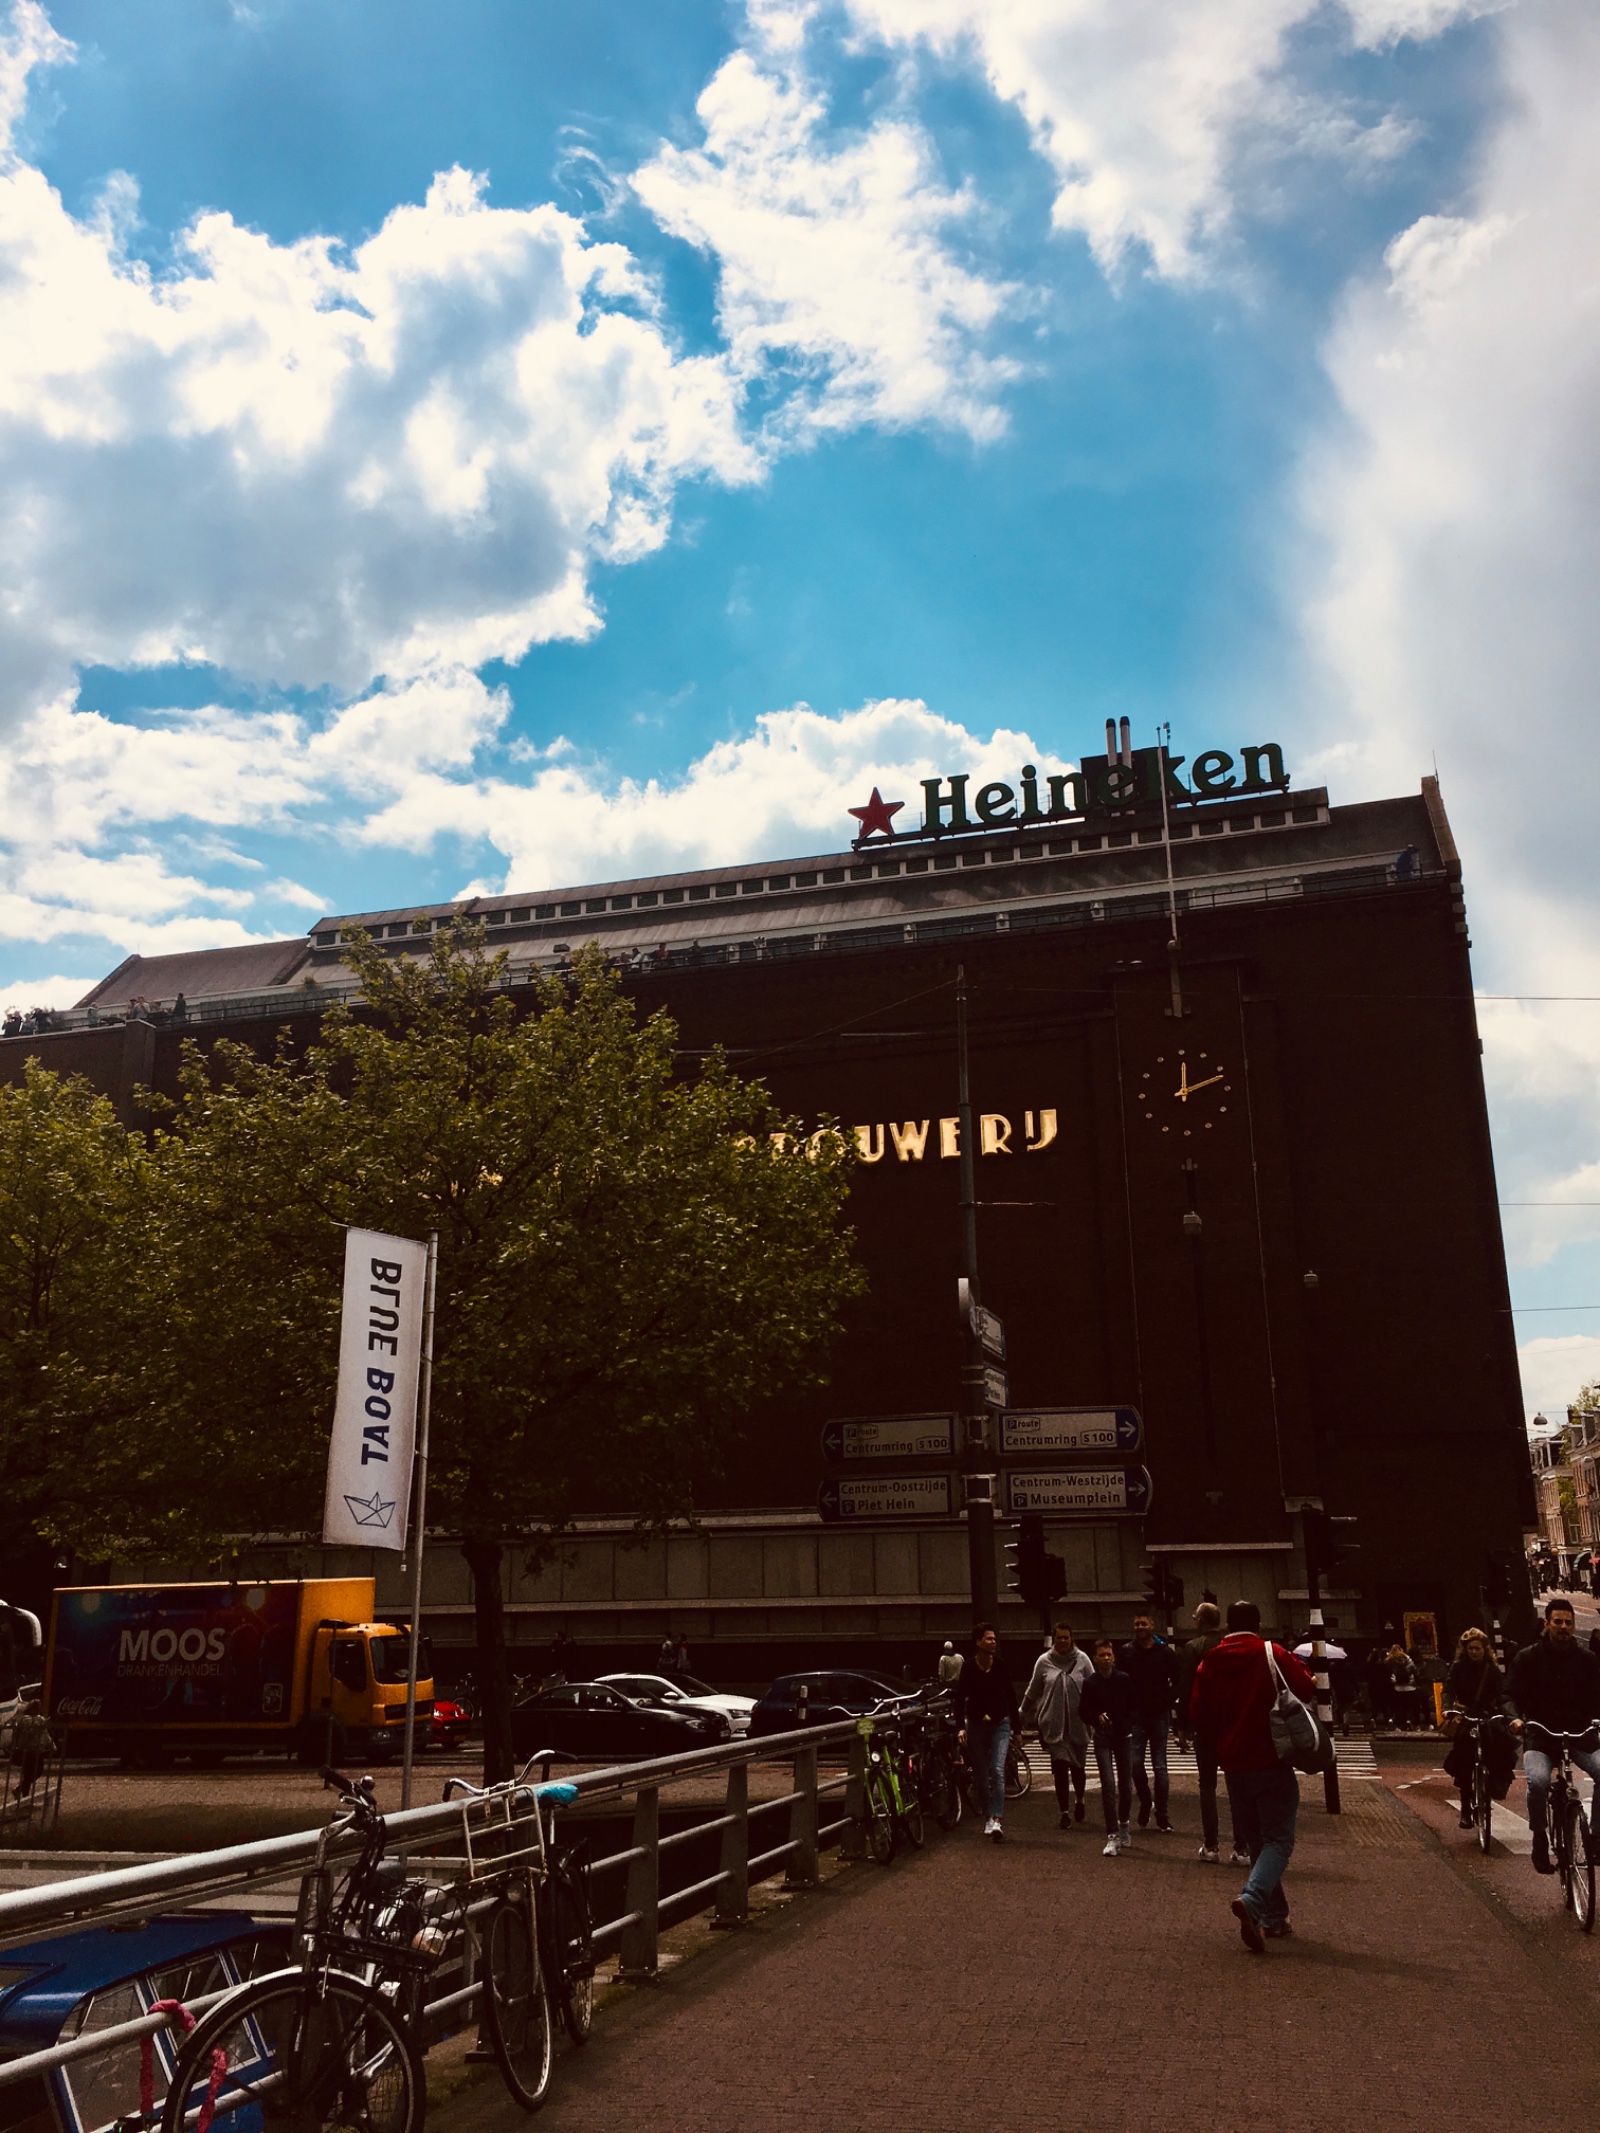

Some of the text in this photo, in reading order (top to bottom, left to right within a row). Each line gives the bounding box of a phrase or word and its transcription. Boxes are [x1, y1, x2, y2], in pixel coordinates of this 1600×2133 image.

[920, 742, 1290, 831] Heineken
[1017, 1420, 1039, 1429] route
[846, 1440, 913, 1454] Centrumring
[928, 1439, 947, 1449] 100
[1005, 1432, 1114, 1447] Centrumring S 100
[841, 1480, 946, 1495] Centrum-Oostzijde
[1012, 1474, 1124, 1488] Centrum-Westzijde
[857, 1499, 883, 1511] Piet
[886, 1498, 915, 1510] Hein
[1030, 1491, 1120, 1506] Museumplein
[118, 1627, 226, 1662] MOOS
[117, 1662, 223, 1678] DRANKENHANDEL
